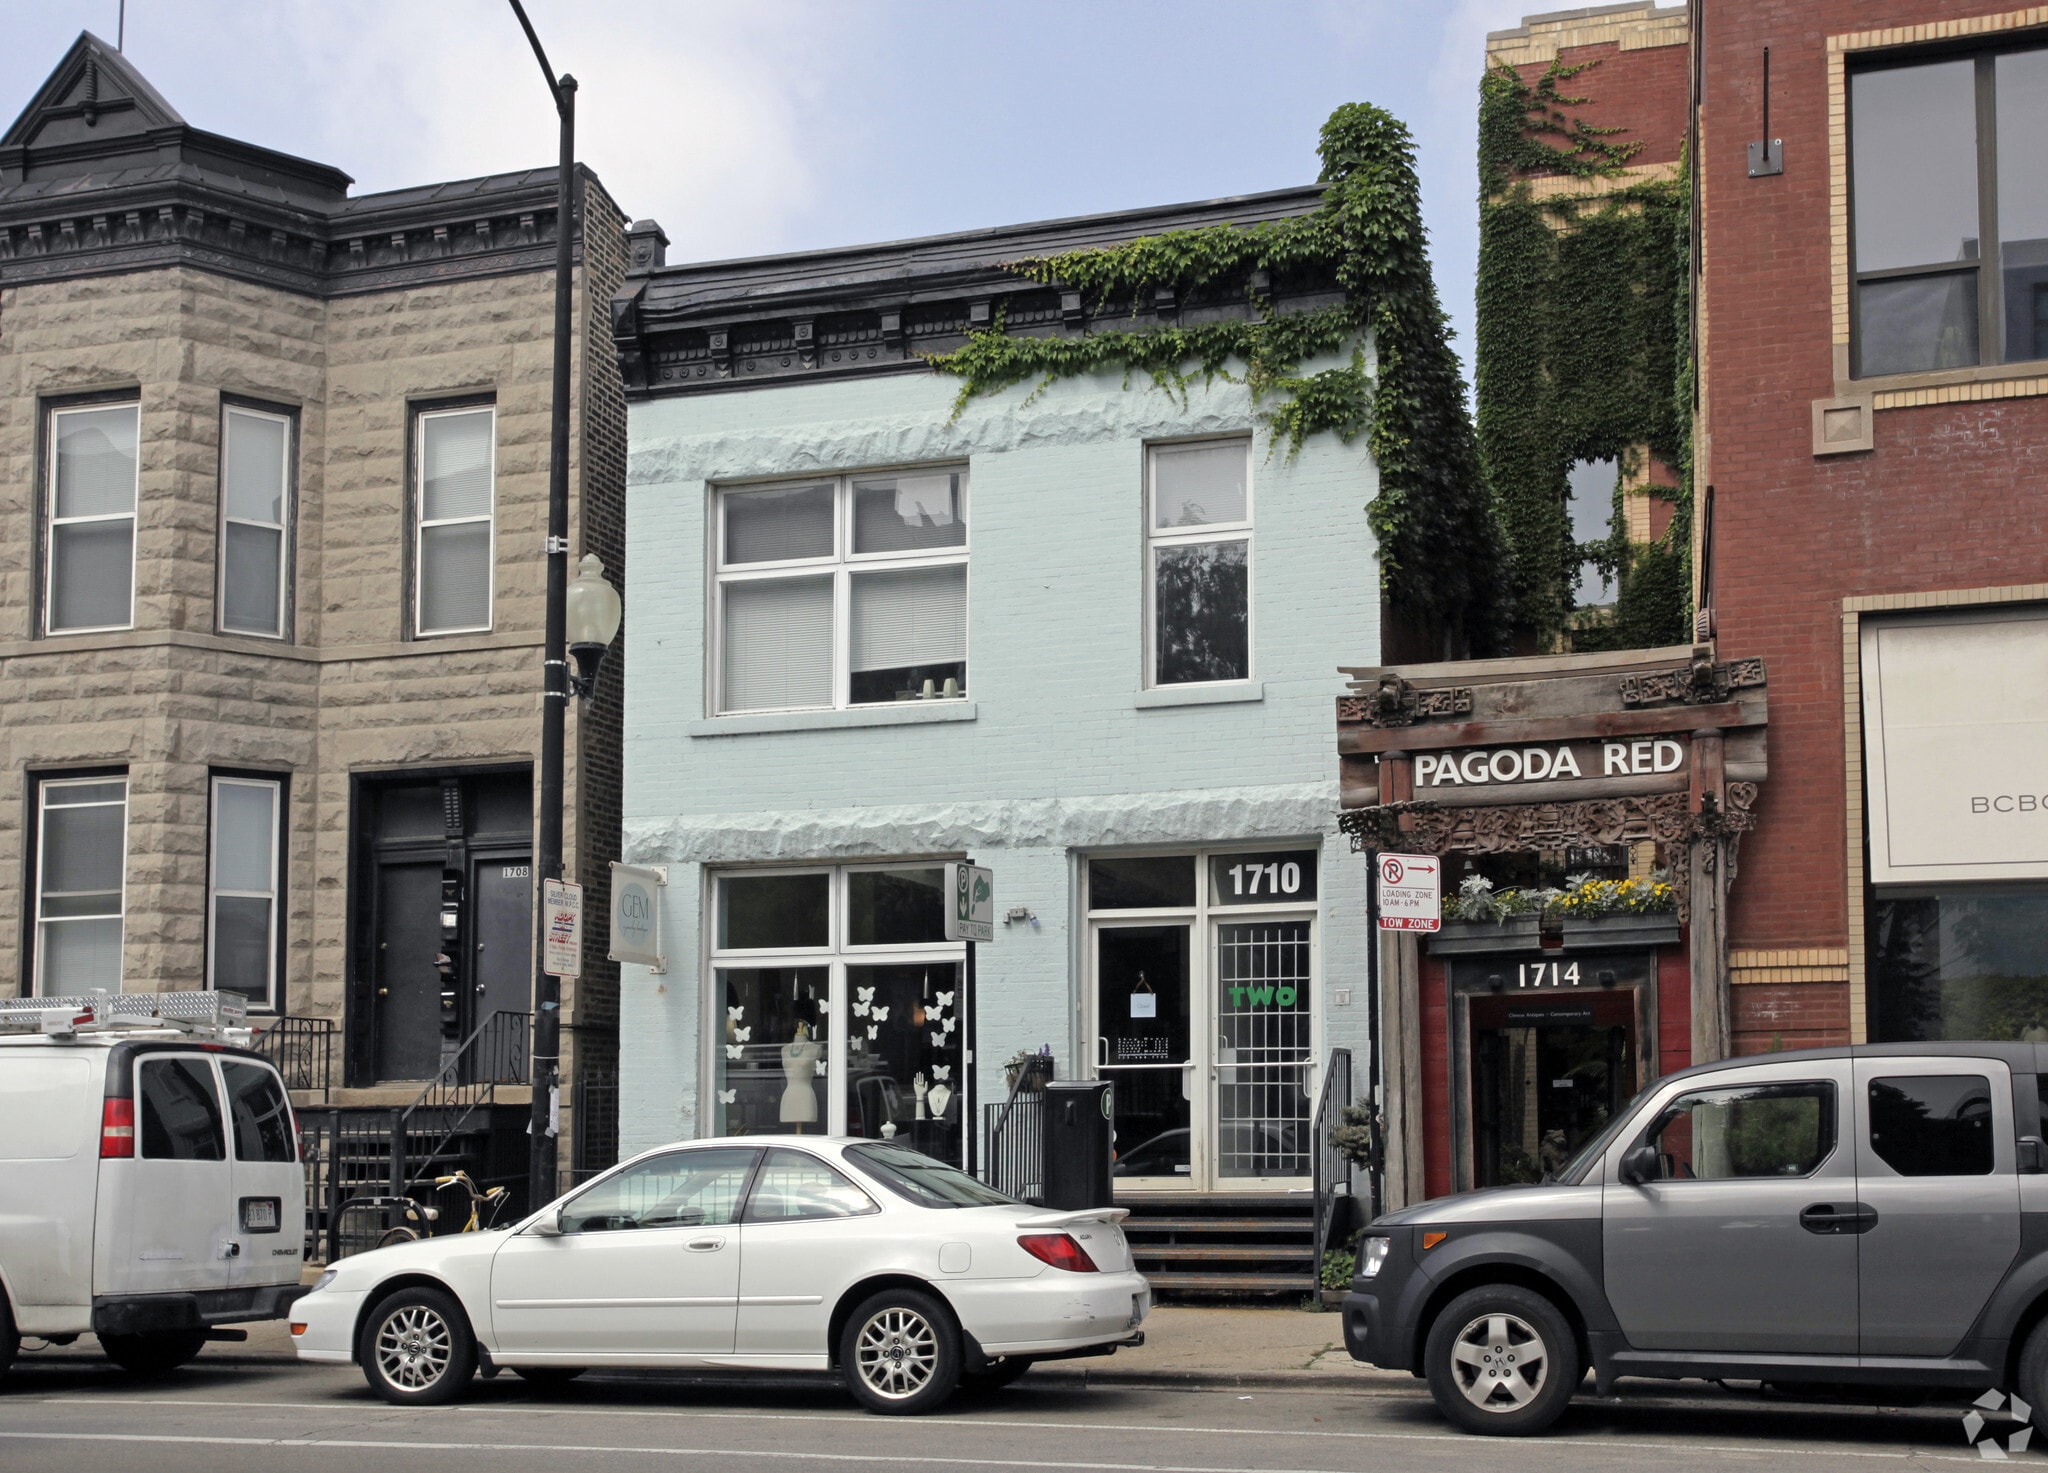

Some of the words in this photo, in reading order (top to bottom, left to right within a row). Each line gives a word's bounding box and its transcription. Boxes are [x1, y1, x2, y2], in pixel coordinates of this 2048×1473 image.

[1415, 746, 1582, 787] PAGODA
[1603, 740, 1683, 776] RED
[504, 867, 528, 877] 1708
[1228, 861, 1300, 895] 1710
[548, 898, 563, 906] MEMBER
[1383, 890, 1411, 898] LOADING
[1415, 891, 1432, 899] ZONE
[621, 893, 648, 920] GEM
[960, 922, 969, 935] PAY
[970, 923, 977, 937] TO
[977, 924, 992, 938] PARK
[1383, 918, 1403, 927] TOW
[1408, 918, 1434, 929] ZONE
[1519, 962, 1580, 987] 1714
[1228, 985, 1297, 1007] TWO
